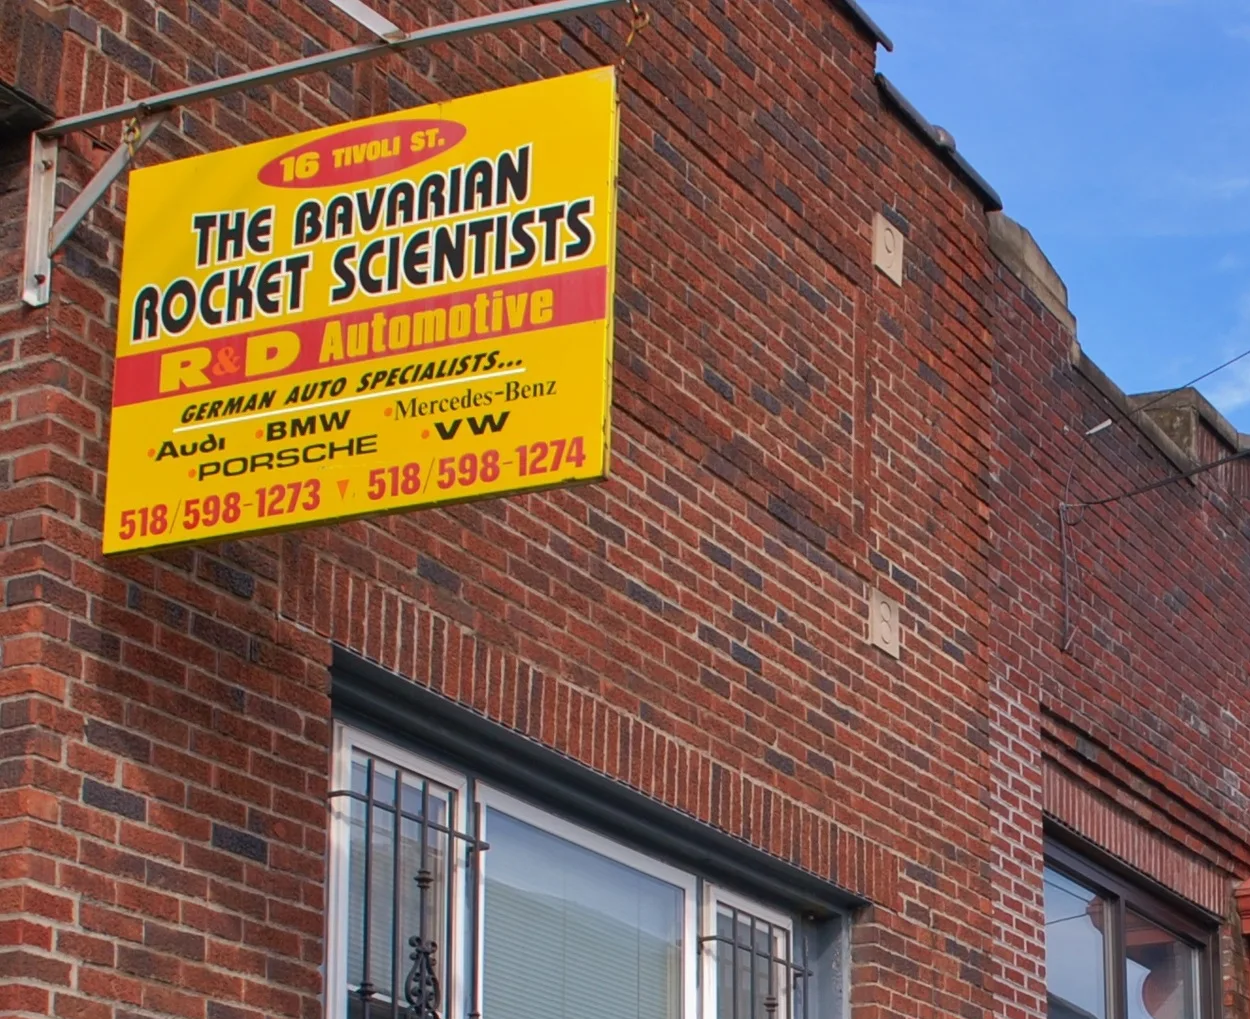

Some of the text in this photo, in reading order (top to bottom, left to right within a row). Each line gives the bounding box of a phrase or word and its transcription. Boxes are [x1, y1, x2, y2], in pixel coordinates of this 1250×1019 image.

[280, 127, 445, 182] 16 TIVOLI ST.
[193, 146, 531, 265] THE BAVARIAN
[133, 200, 594, 341] ROCKET SCIENTISTS
[158, 287, 554, 393] R&D Automotive
[155, 376, 557, 461] Audi BMW Mercedes-Benz
[181, 391, 277, 424] GERMAN
[285, 376, 347, 405] AUTO
[198, 411, 510, 481] PORSCHE VW
[119, 436, 586, 540] 518/598-1273 518/598-1274
